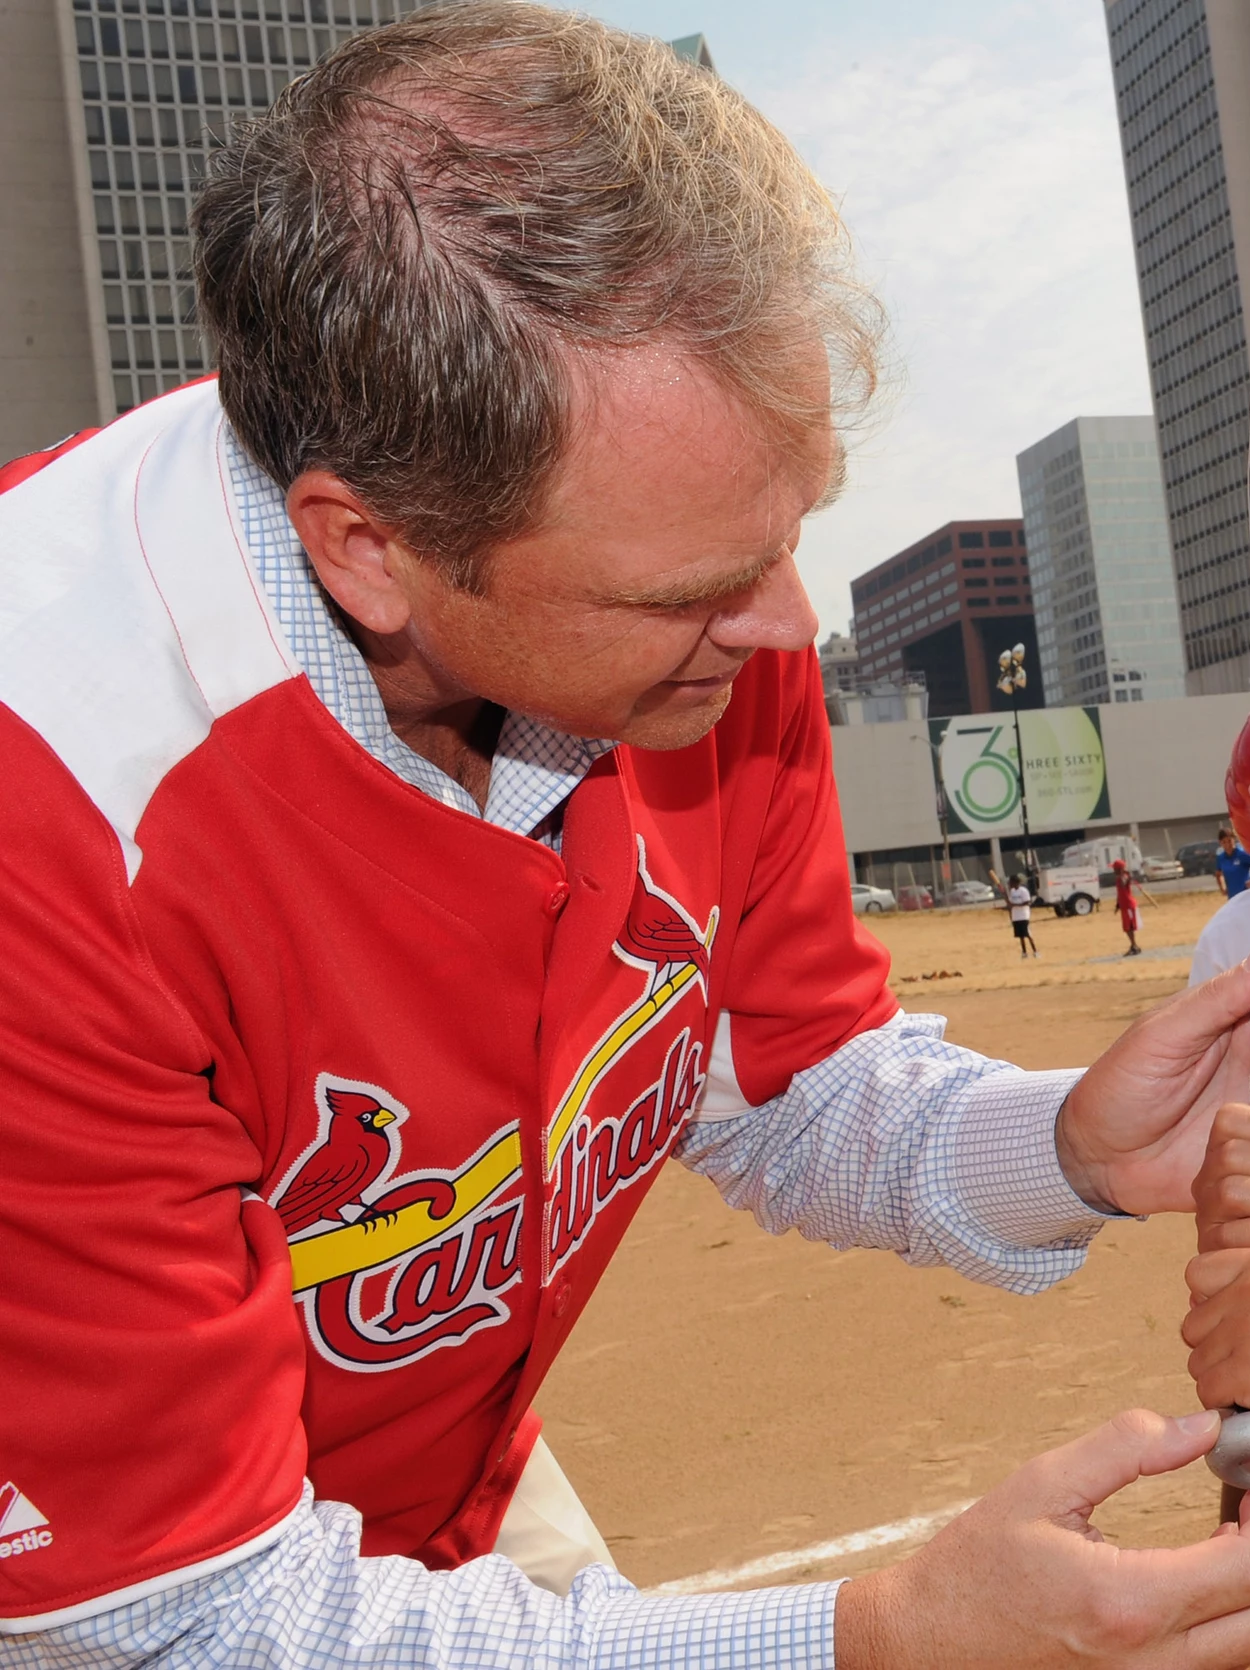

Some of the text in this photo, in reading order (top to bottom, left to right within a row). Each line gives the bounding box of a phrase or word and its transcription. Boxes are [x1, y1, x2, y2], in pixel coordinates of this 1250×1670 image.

[1025, 754, 1101, 769] HREE SIXTY
[304, 1027, 705, 1372] Cardinals
[0, 1529, 53, 1558] estic
